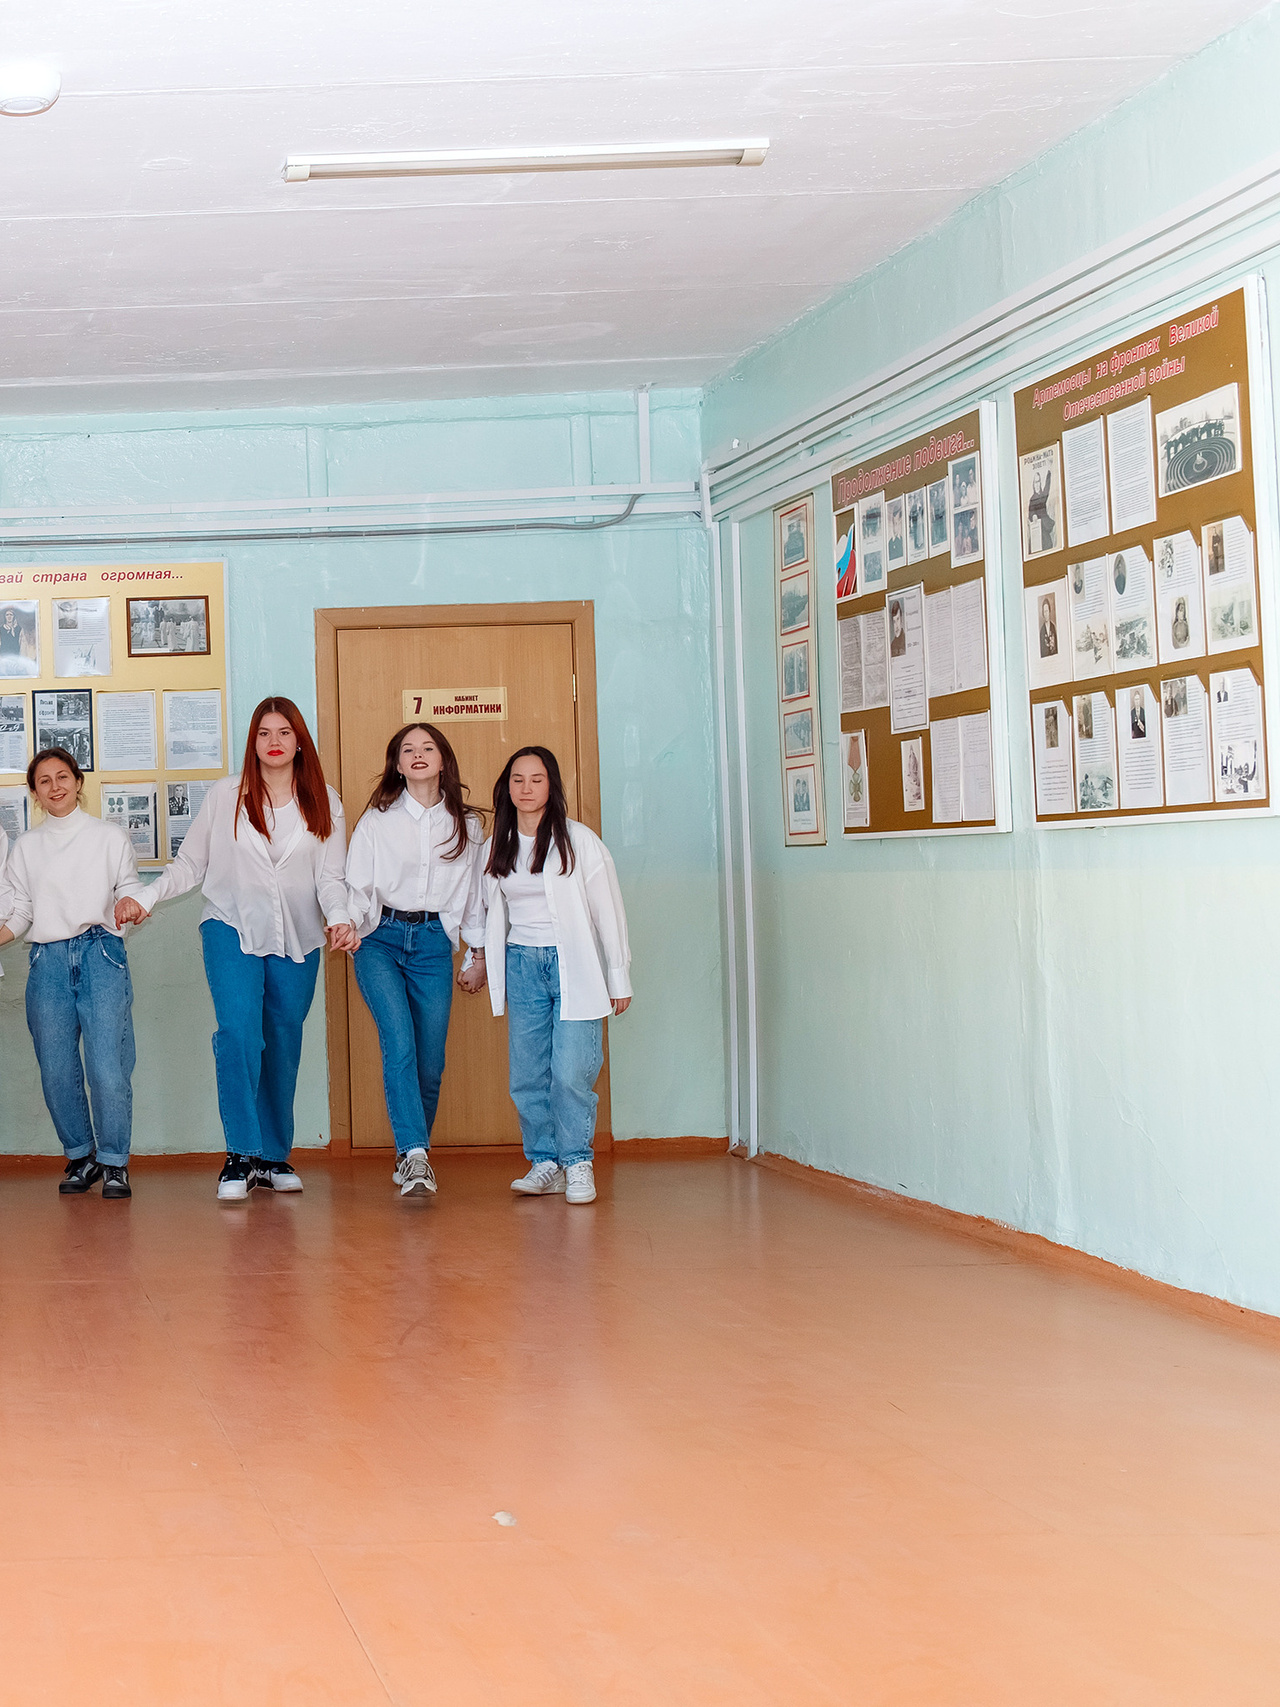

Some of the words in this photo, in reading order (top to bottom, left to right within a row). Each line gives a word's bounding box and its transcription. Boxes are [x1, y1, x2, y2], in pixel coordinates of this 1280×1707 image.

[1032, 367, 1092, 410] Артемовцы
[1095, 358, 1108, 379] на
[1110, 335, 1161, 377] фронтах
[1168, 305, 1219, 347] Великой
[1062, 367, 1147, 422] Отечественной
[1148, 356, 1185, 385] войны
[837, 454, 912, 507] Продолжение
[913, 430, 975, 472] подвига...
[32, 571, 87, 585] страна
[101, 569, 183, 583] огромная...
[413, 697, 422, 714] 7
[433, 703, 502, 715] ИНФОРМАТИКИ
